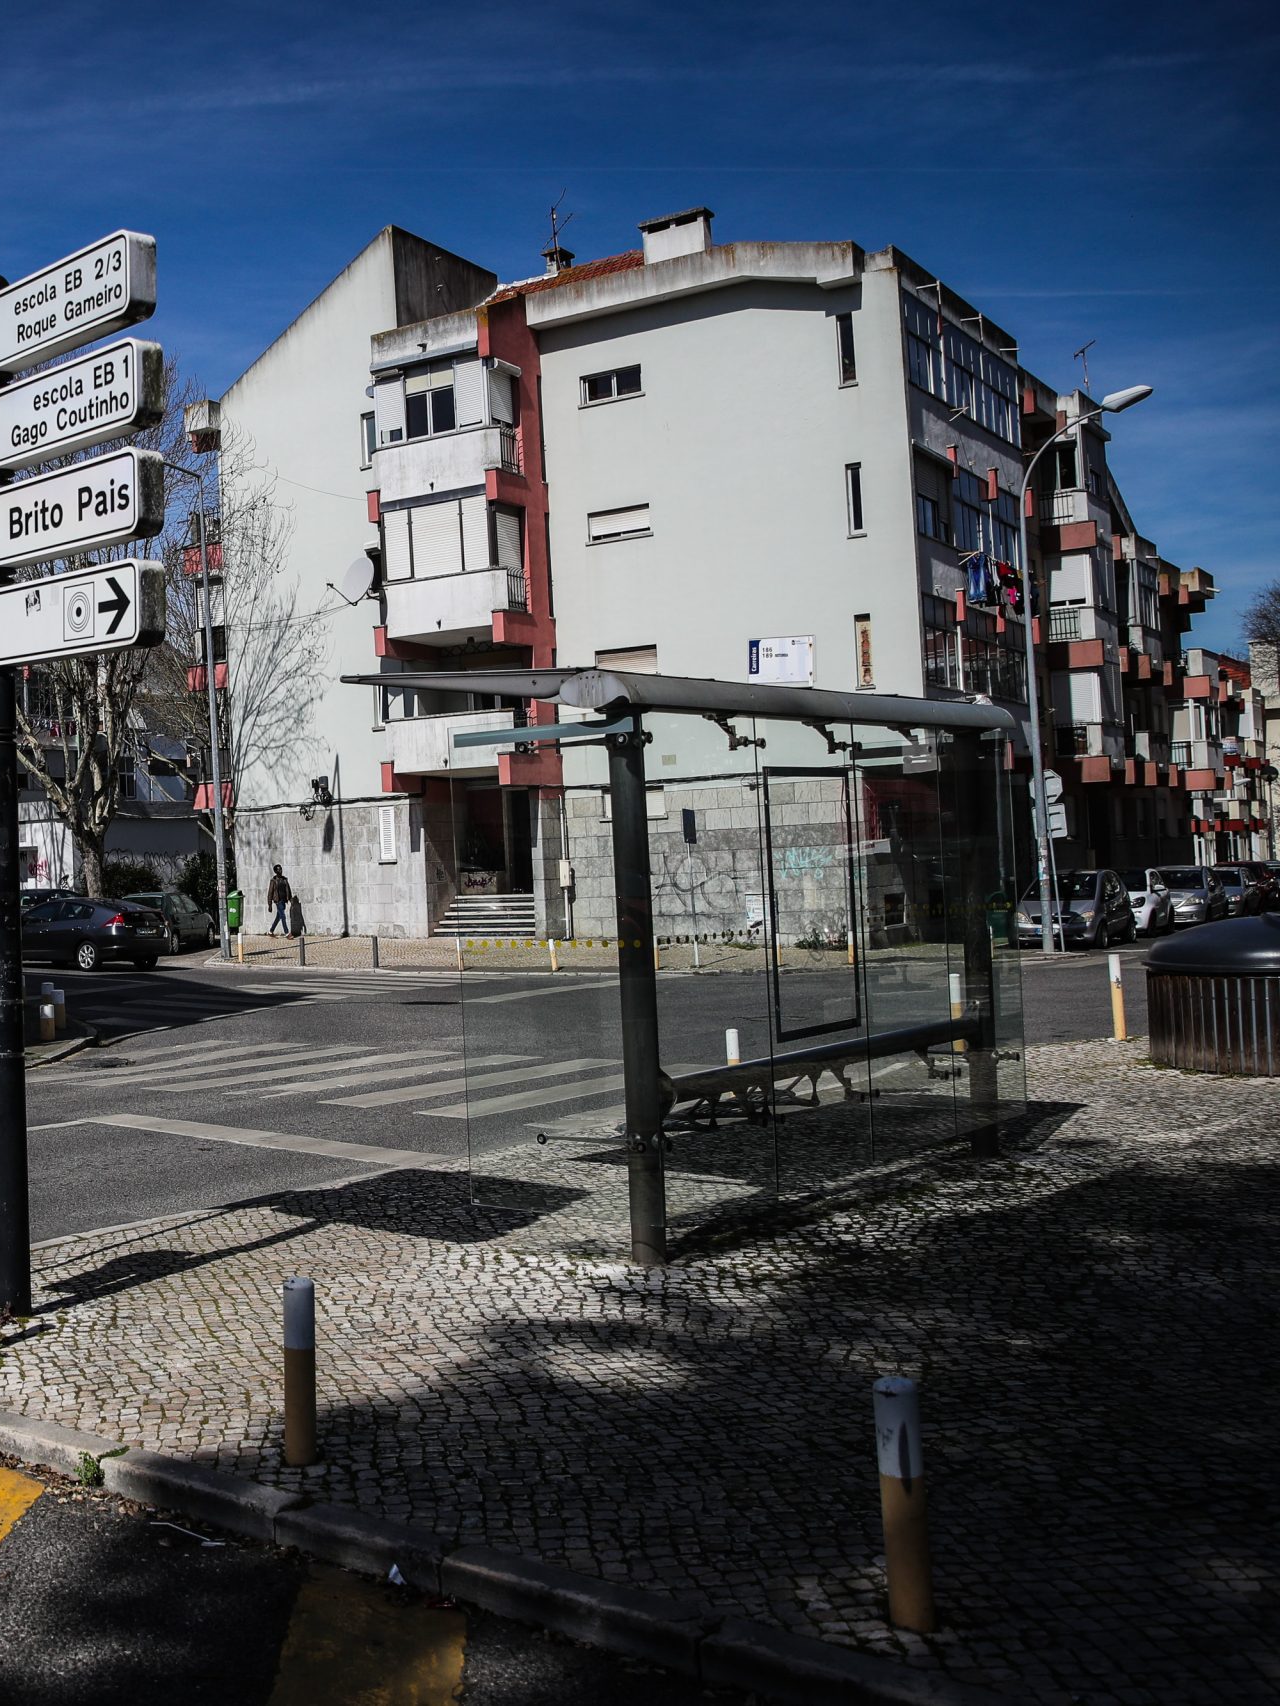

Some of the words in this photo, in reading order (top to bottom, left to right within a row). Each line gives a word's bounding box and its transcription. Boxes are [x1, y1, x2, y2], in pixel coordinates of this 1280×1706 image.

[14, 283, 57, 316] escola
[64, 268, 83, 294] EB
[94, 250, 122, 281] 2/3
[17, 313, 57, 344] Roque
[64, 284, 122, 322] Gameiro
[33, 376, 84, 411] escola
[93, 361, 115, 390] EB
[122, 354, 129, 379] 1
[11, 421, 48, 447] Gago
[56, 390, 129, 431] Coutinho
[9, 497, 64, 540] Brito
[77, 480, 130, 521] Pais
